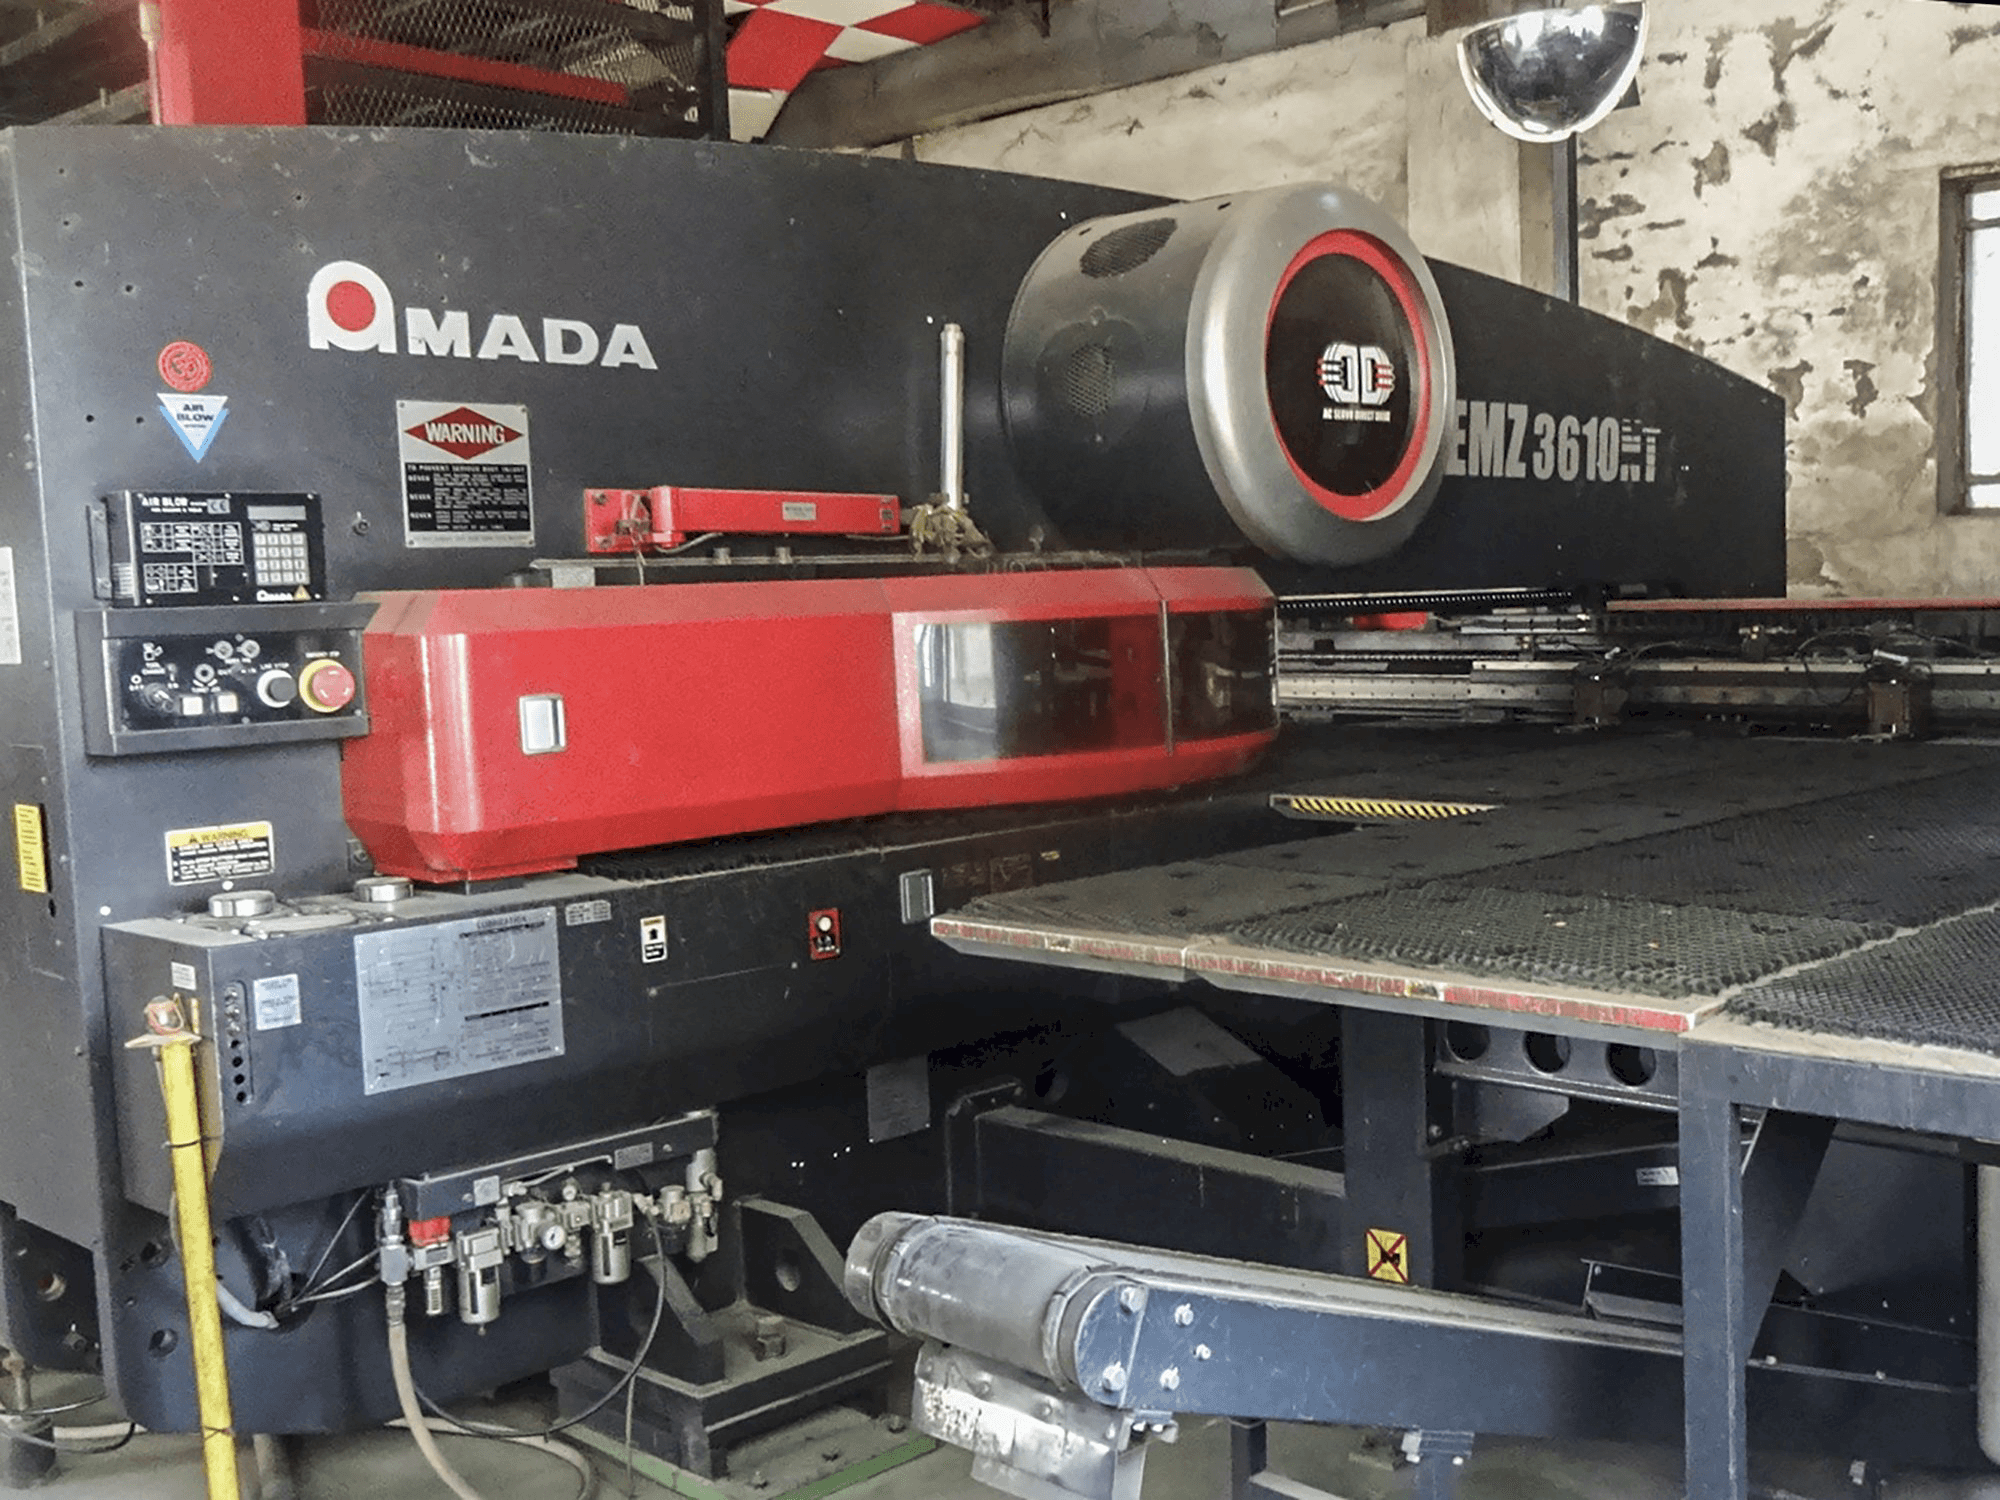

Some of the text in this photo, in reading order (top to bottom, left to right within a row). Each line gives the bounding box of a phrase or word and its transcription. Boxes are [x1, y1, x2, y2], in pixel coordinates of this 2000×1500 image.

[307, 260, 658, 370] AMADA
[183, 404, 204, 412] AIR
[176, 413, 214, 421] BLOW
[424, 422, 505, 444] WARNING
